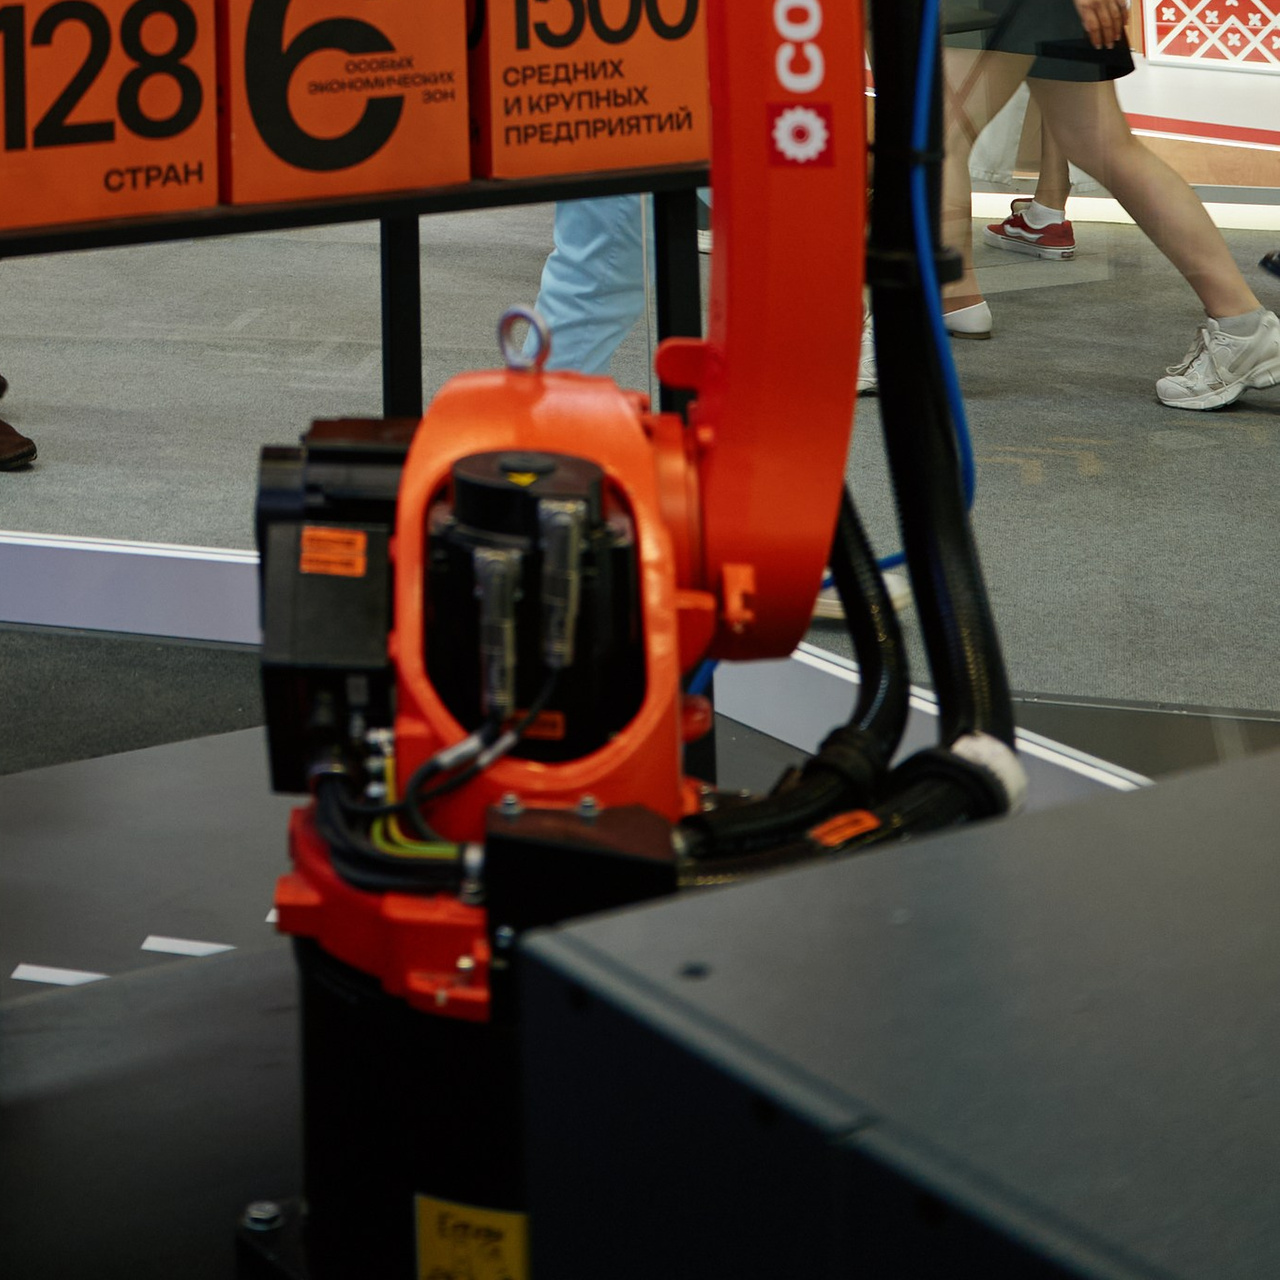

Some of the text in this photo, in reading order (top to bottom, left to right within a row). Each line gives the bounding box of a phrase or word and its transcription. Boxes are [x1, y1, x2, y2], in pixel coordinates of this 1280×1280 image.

[503, 59, 624, 87] СРЕДНИХ
[504, 87, 649, 116] И КРУПНЫХ
[504, 106, 693, 146] ПРЕДПРИЯТИЙ
[103, 161, 204, 193] СТРАН
